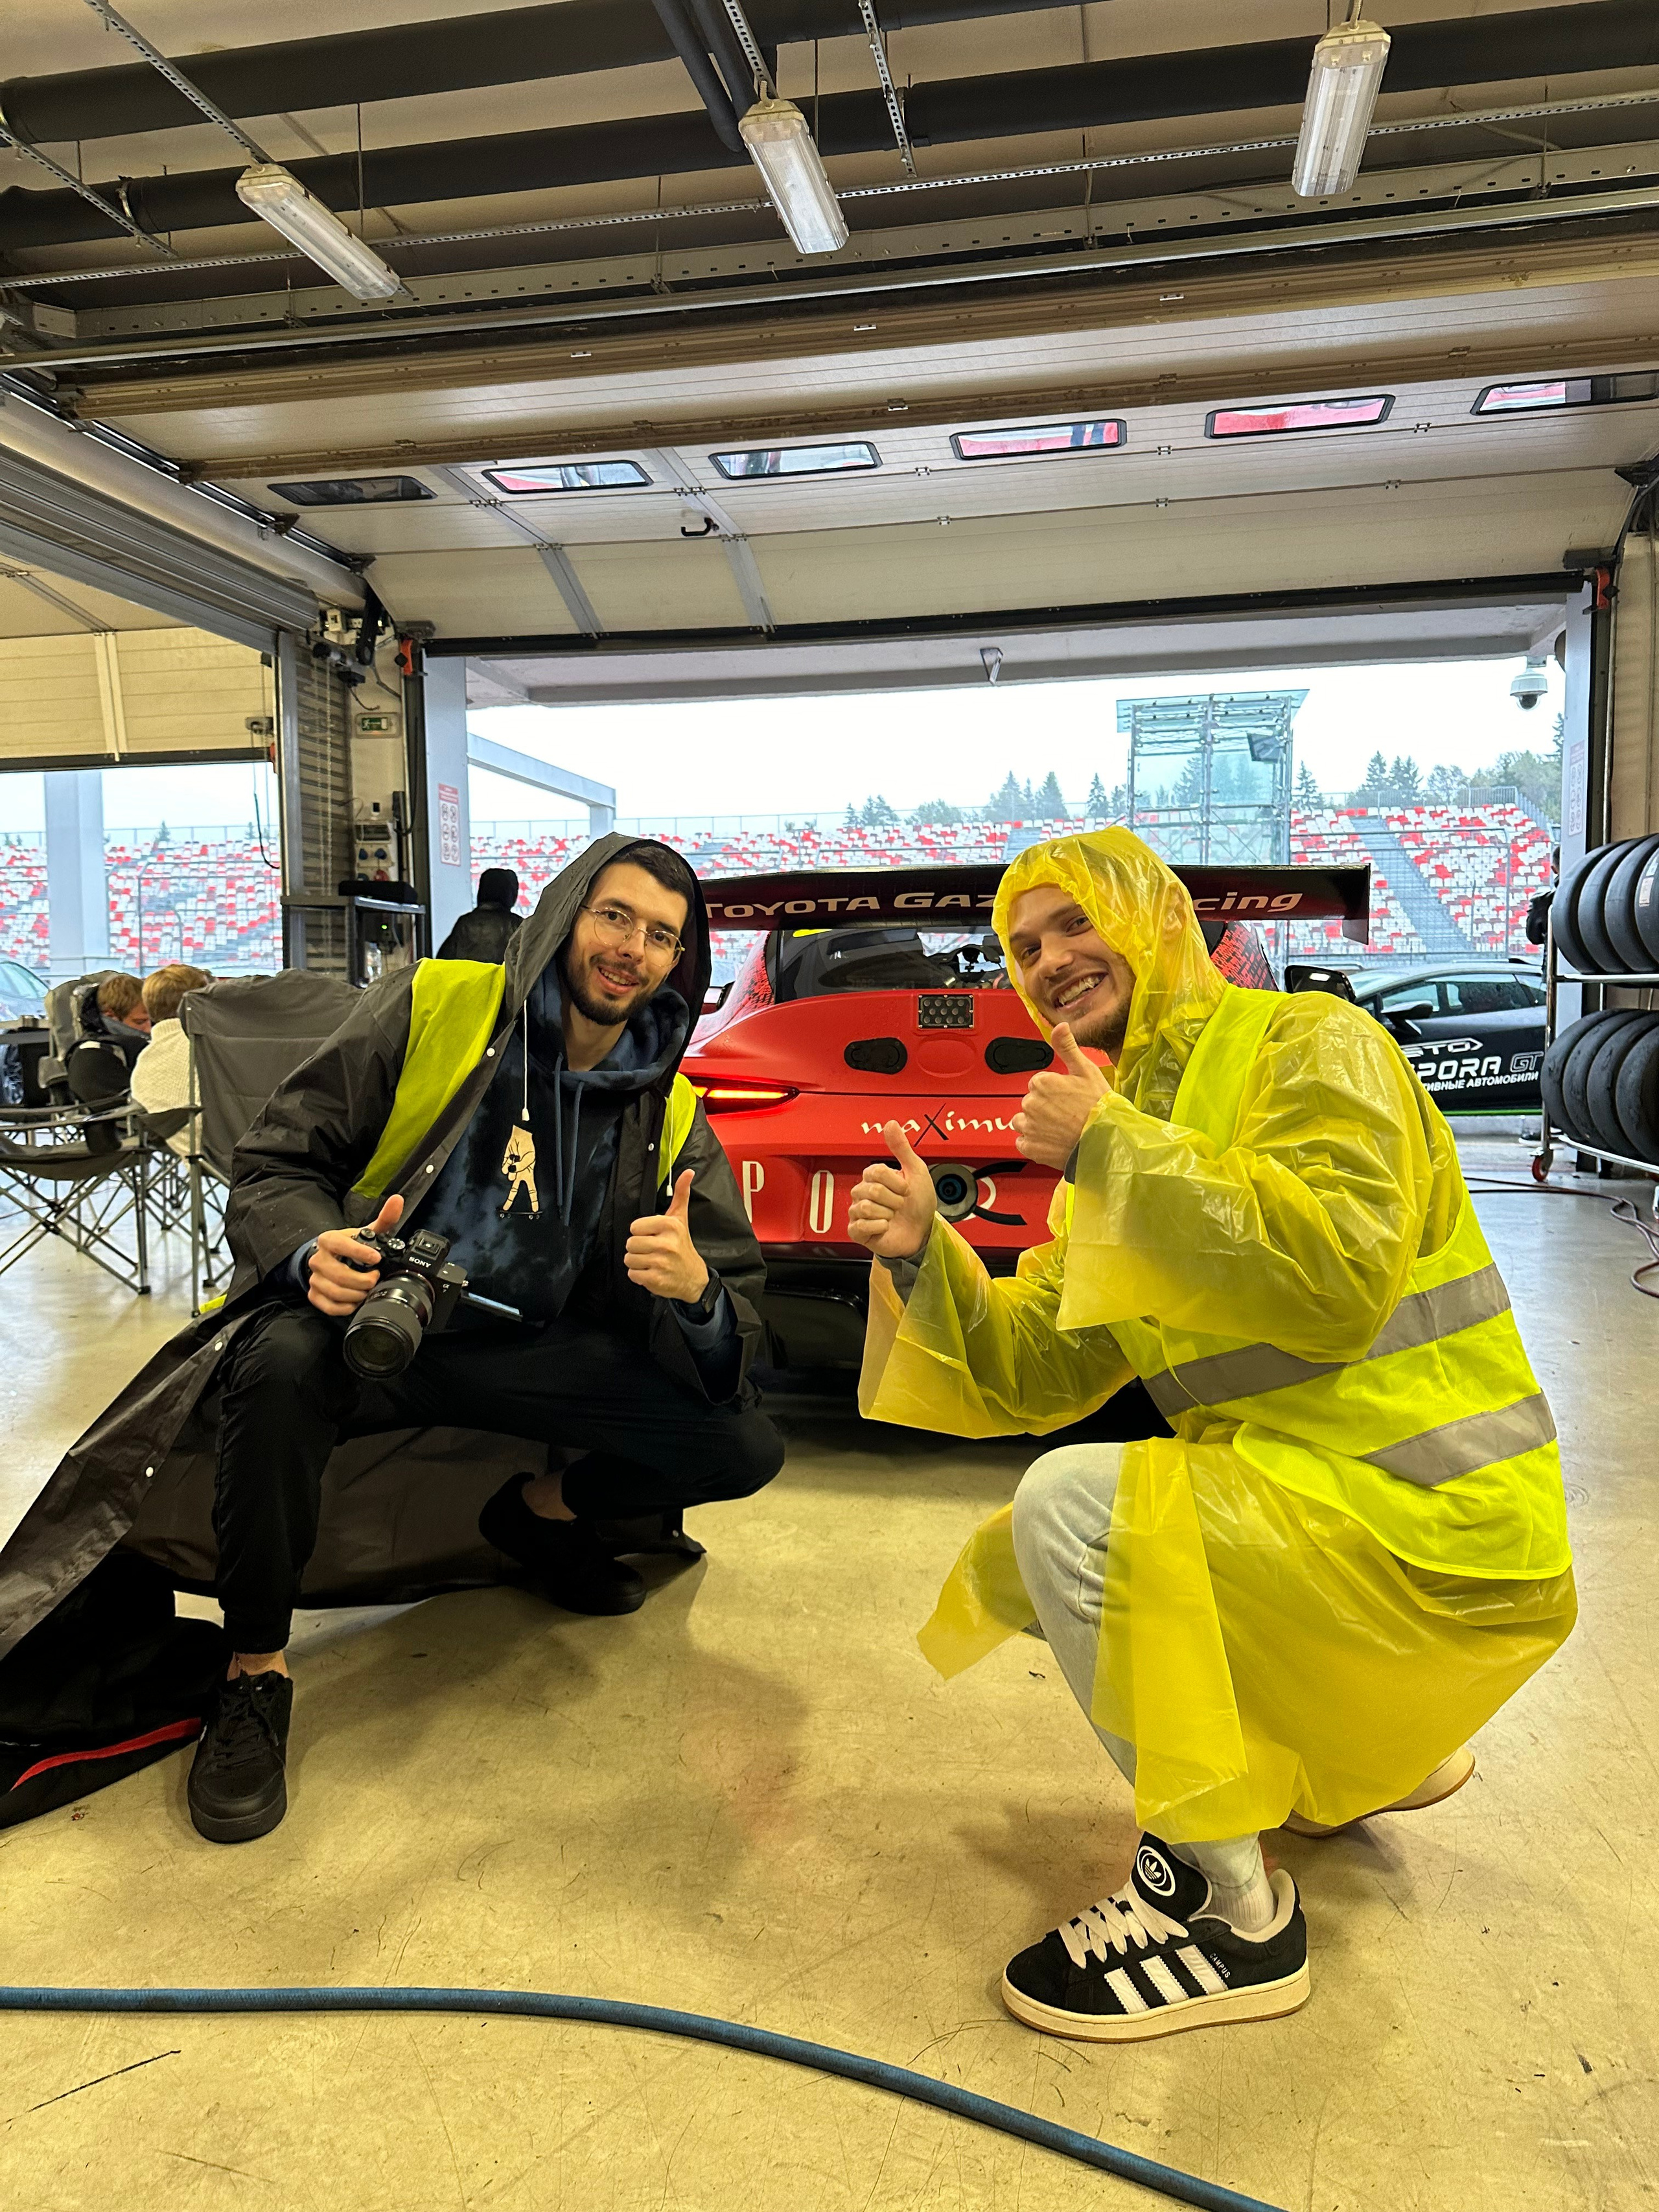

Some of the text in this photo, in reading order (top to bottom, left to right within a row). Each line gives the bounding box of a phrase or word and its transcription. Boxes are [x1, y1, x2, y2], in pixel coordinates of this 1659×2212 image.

[705, 892, 1303, 918] TOYOTA GAZ cing
[1413, 1051, 1544, 1081] PORA GT
[1424, 1071, 1539, 1092] ТИВНЫЕ АВТОМОБИЛИ
[861, 1103, 1014, 1147] maXimu
[408, 1256, 432, 1268] SONY
[1209, 1953, 1231, 1978] CAMPUS
